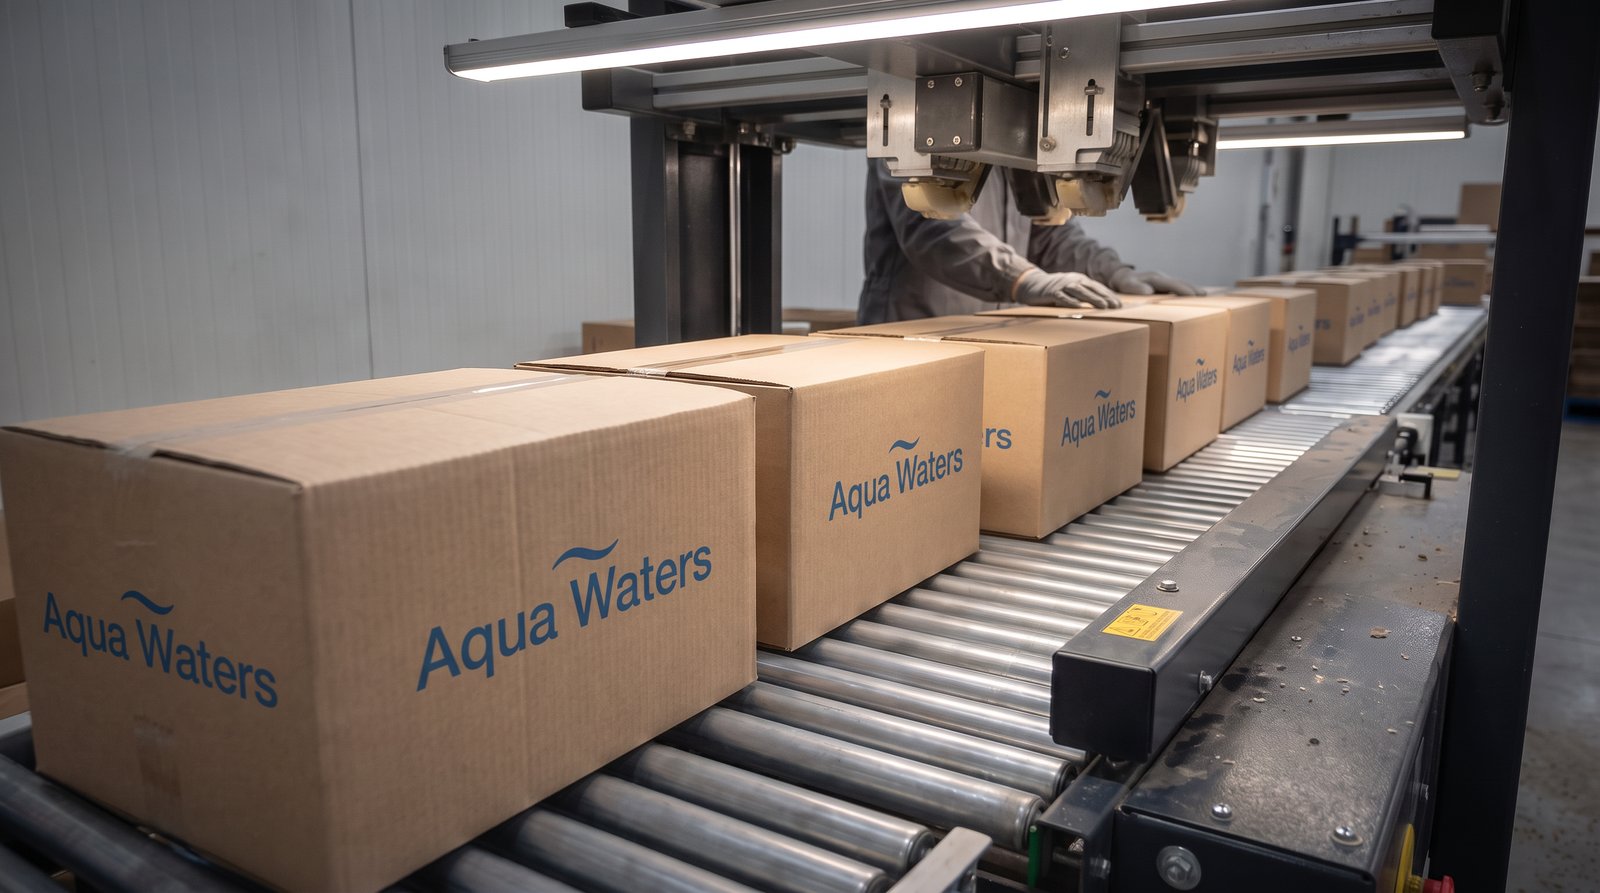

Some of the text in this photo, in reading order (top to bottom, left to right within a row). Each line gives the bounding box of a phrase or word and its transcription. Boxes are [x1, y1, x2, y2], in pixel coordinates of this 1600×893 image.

[1176, 368, 1218, 403] Aqua Waters
[1232, 347, 1265, 375] Aqua Waters
[982, 428, 1012, 450] rs
[1061, 399, 1137, 448] Aqua Waters
[828, 448, 963, 521] Aqua Waters
[415, 545, 713, 692] Aqua Waters
[42, 591, 279, 709] Aqua Waters
